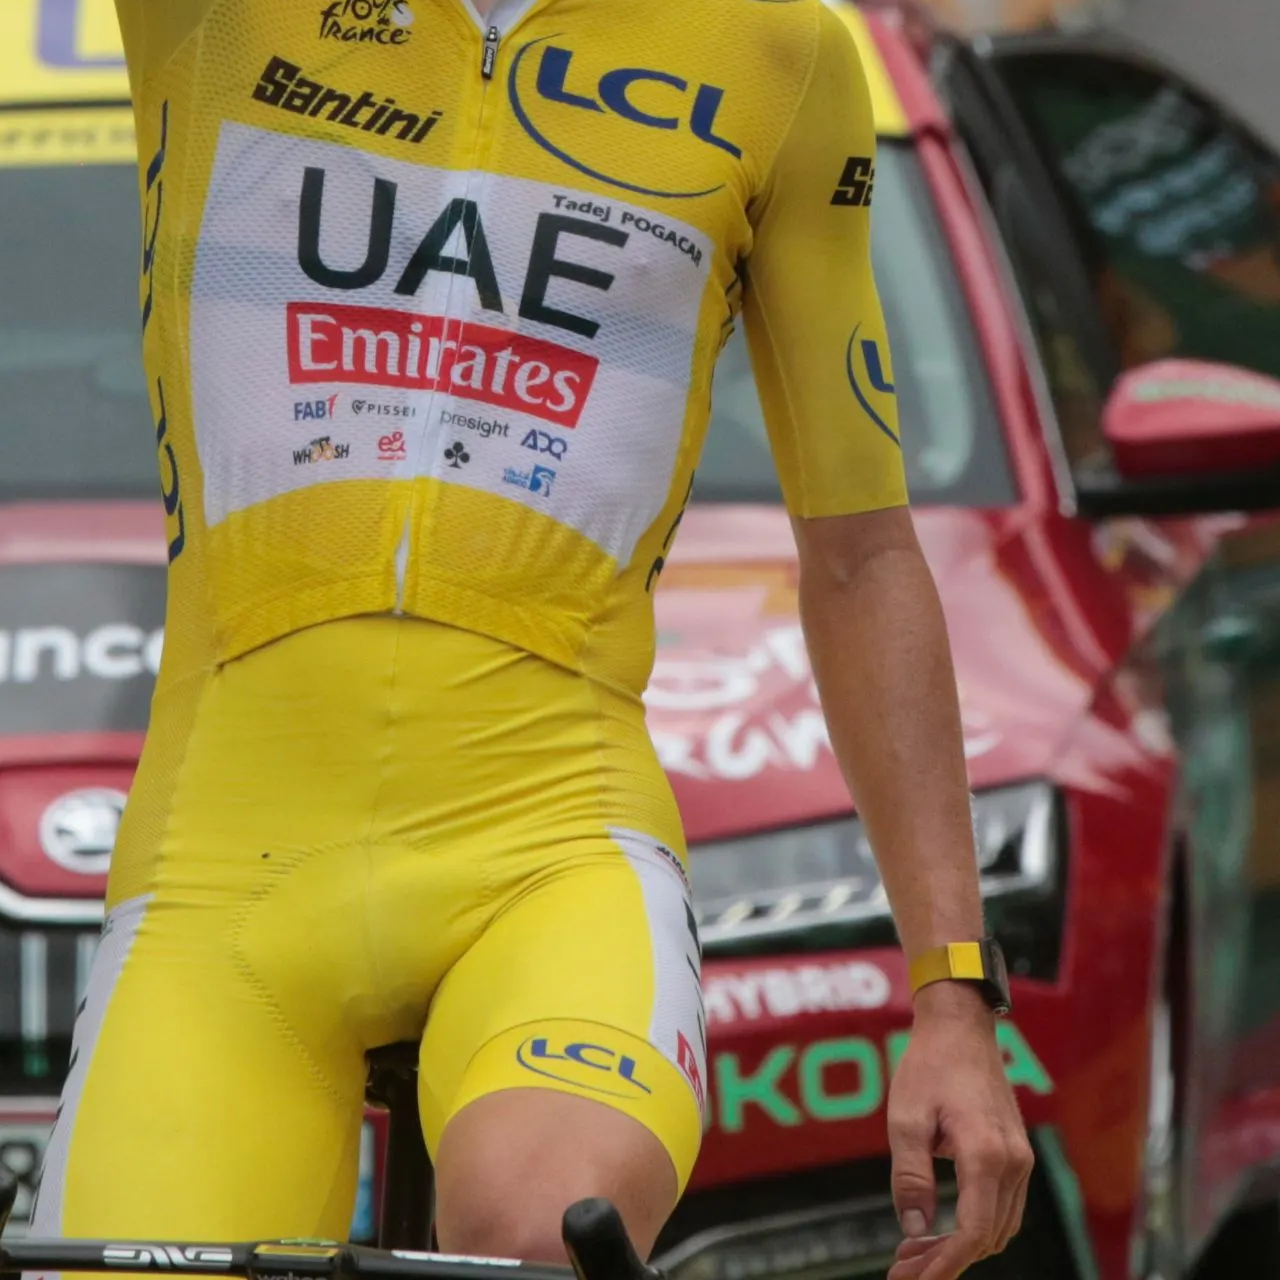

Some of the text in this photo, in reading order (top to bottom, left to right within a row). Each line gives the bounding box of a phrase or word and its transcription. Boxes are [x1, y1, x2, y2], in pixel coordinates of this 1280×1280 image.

[251, 55, 444, 144] Santini
[536, 45, 743, 160] LCL
[297, 166, 631, 340] UAE
[552, 194, 612, 223] Tadej
[296, 313, 582, 413] Emirates
[440, 410, 511, 439] presight
[531, 1038, 652, 1095] LCL
